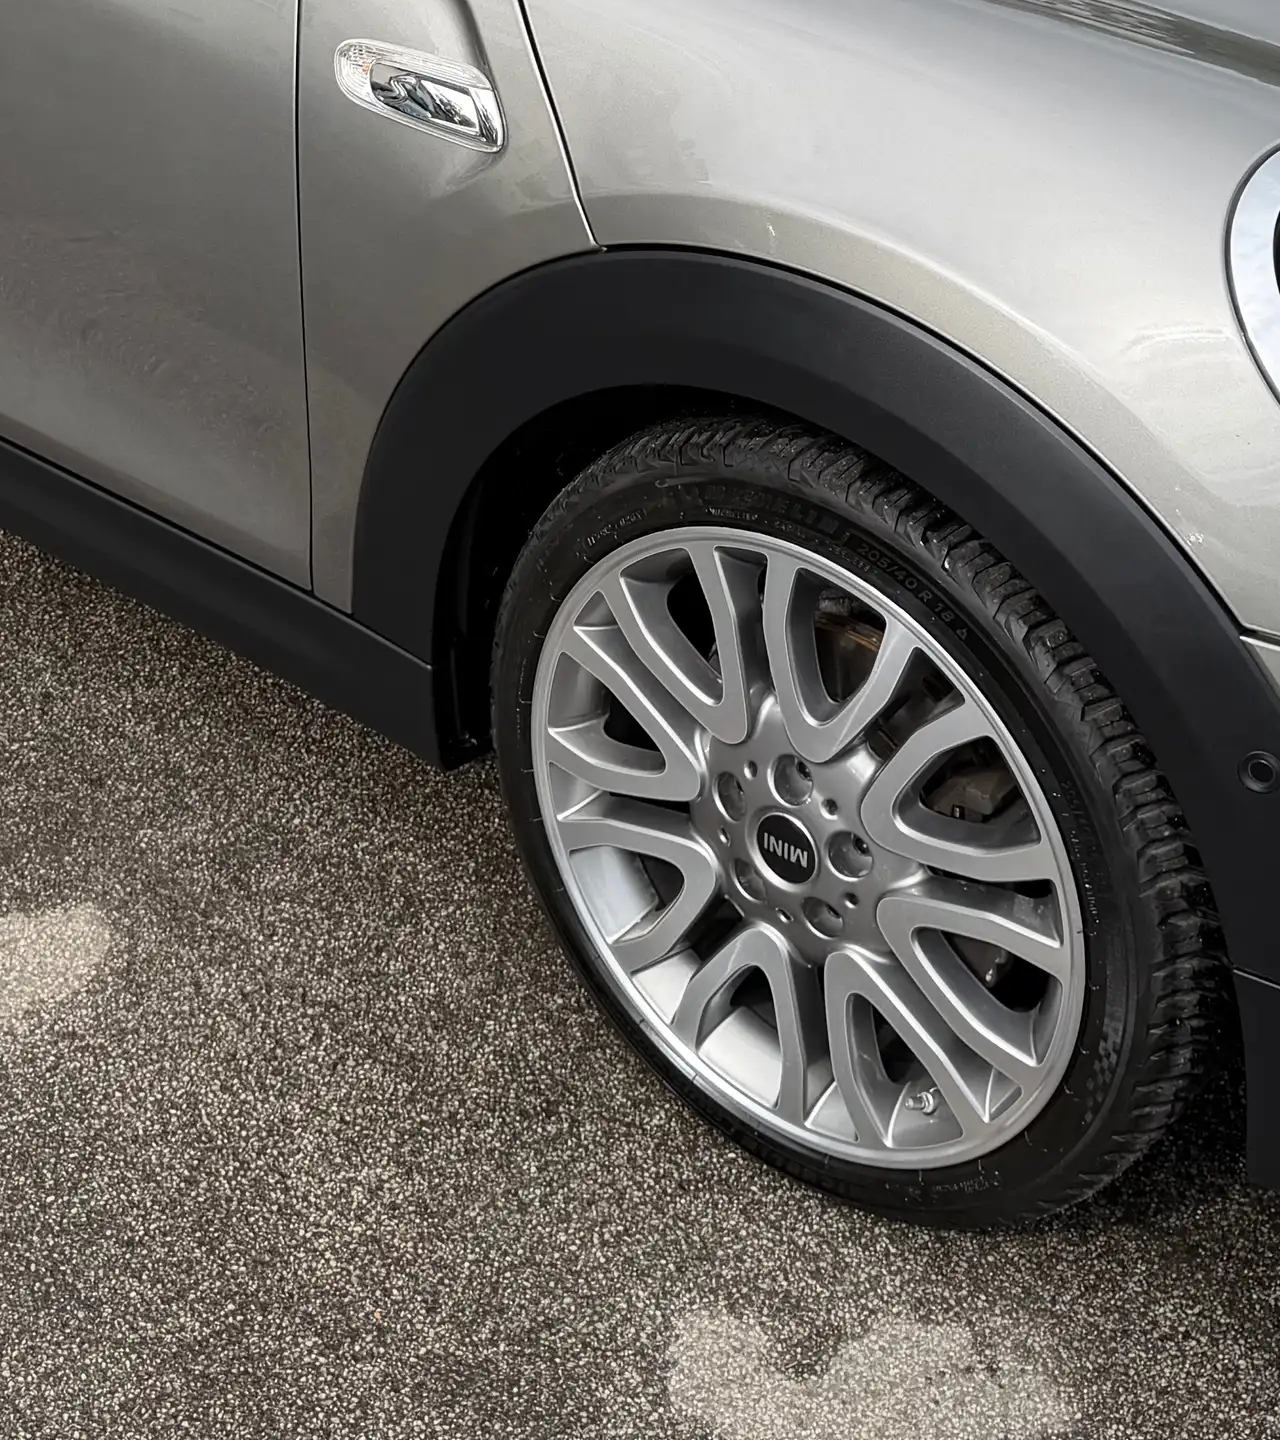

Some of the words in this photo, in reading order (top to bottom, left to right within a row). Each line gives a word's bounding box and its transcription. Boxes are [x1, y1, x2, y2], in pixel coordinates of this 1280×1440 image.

[855, 541, 919, 590] 205/40
[919, 591, 933, 604] R
[936, 602, 955, 622] 18
[763, 832, 808, 868] MINI
